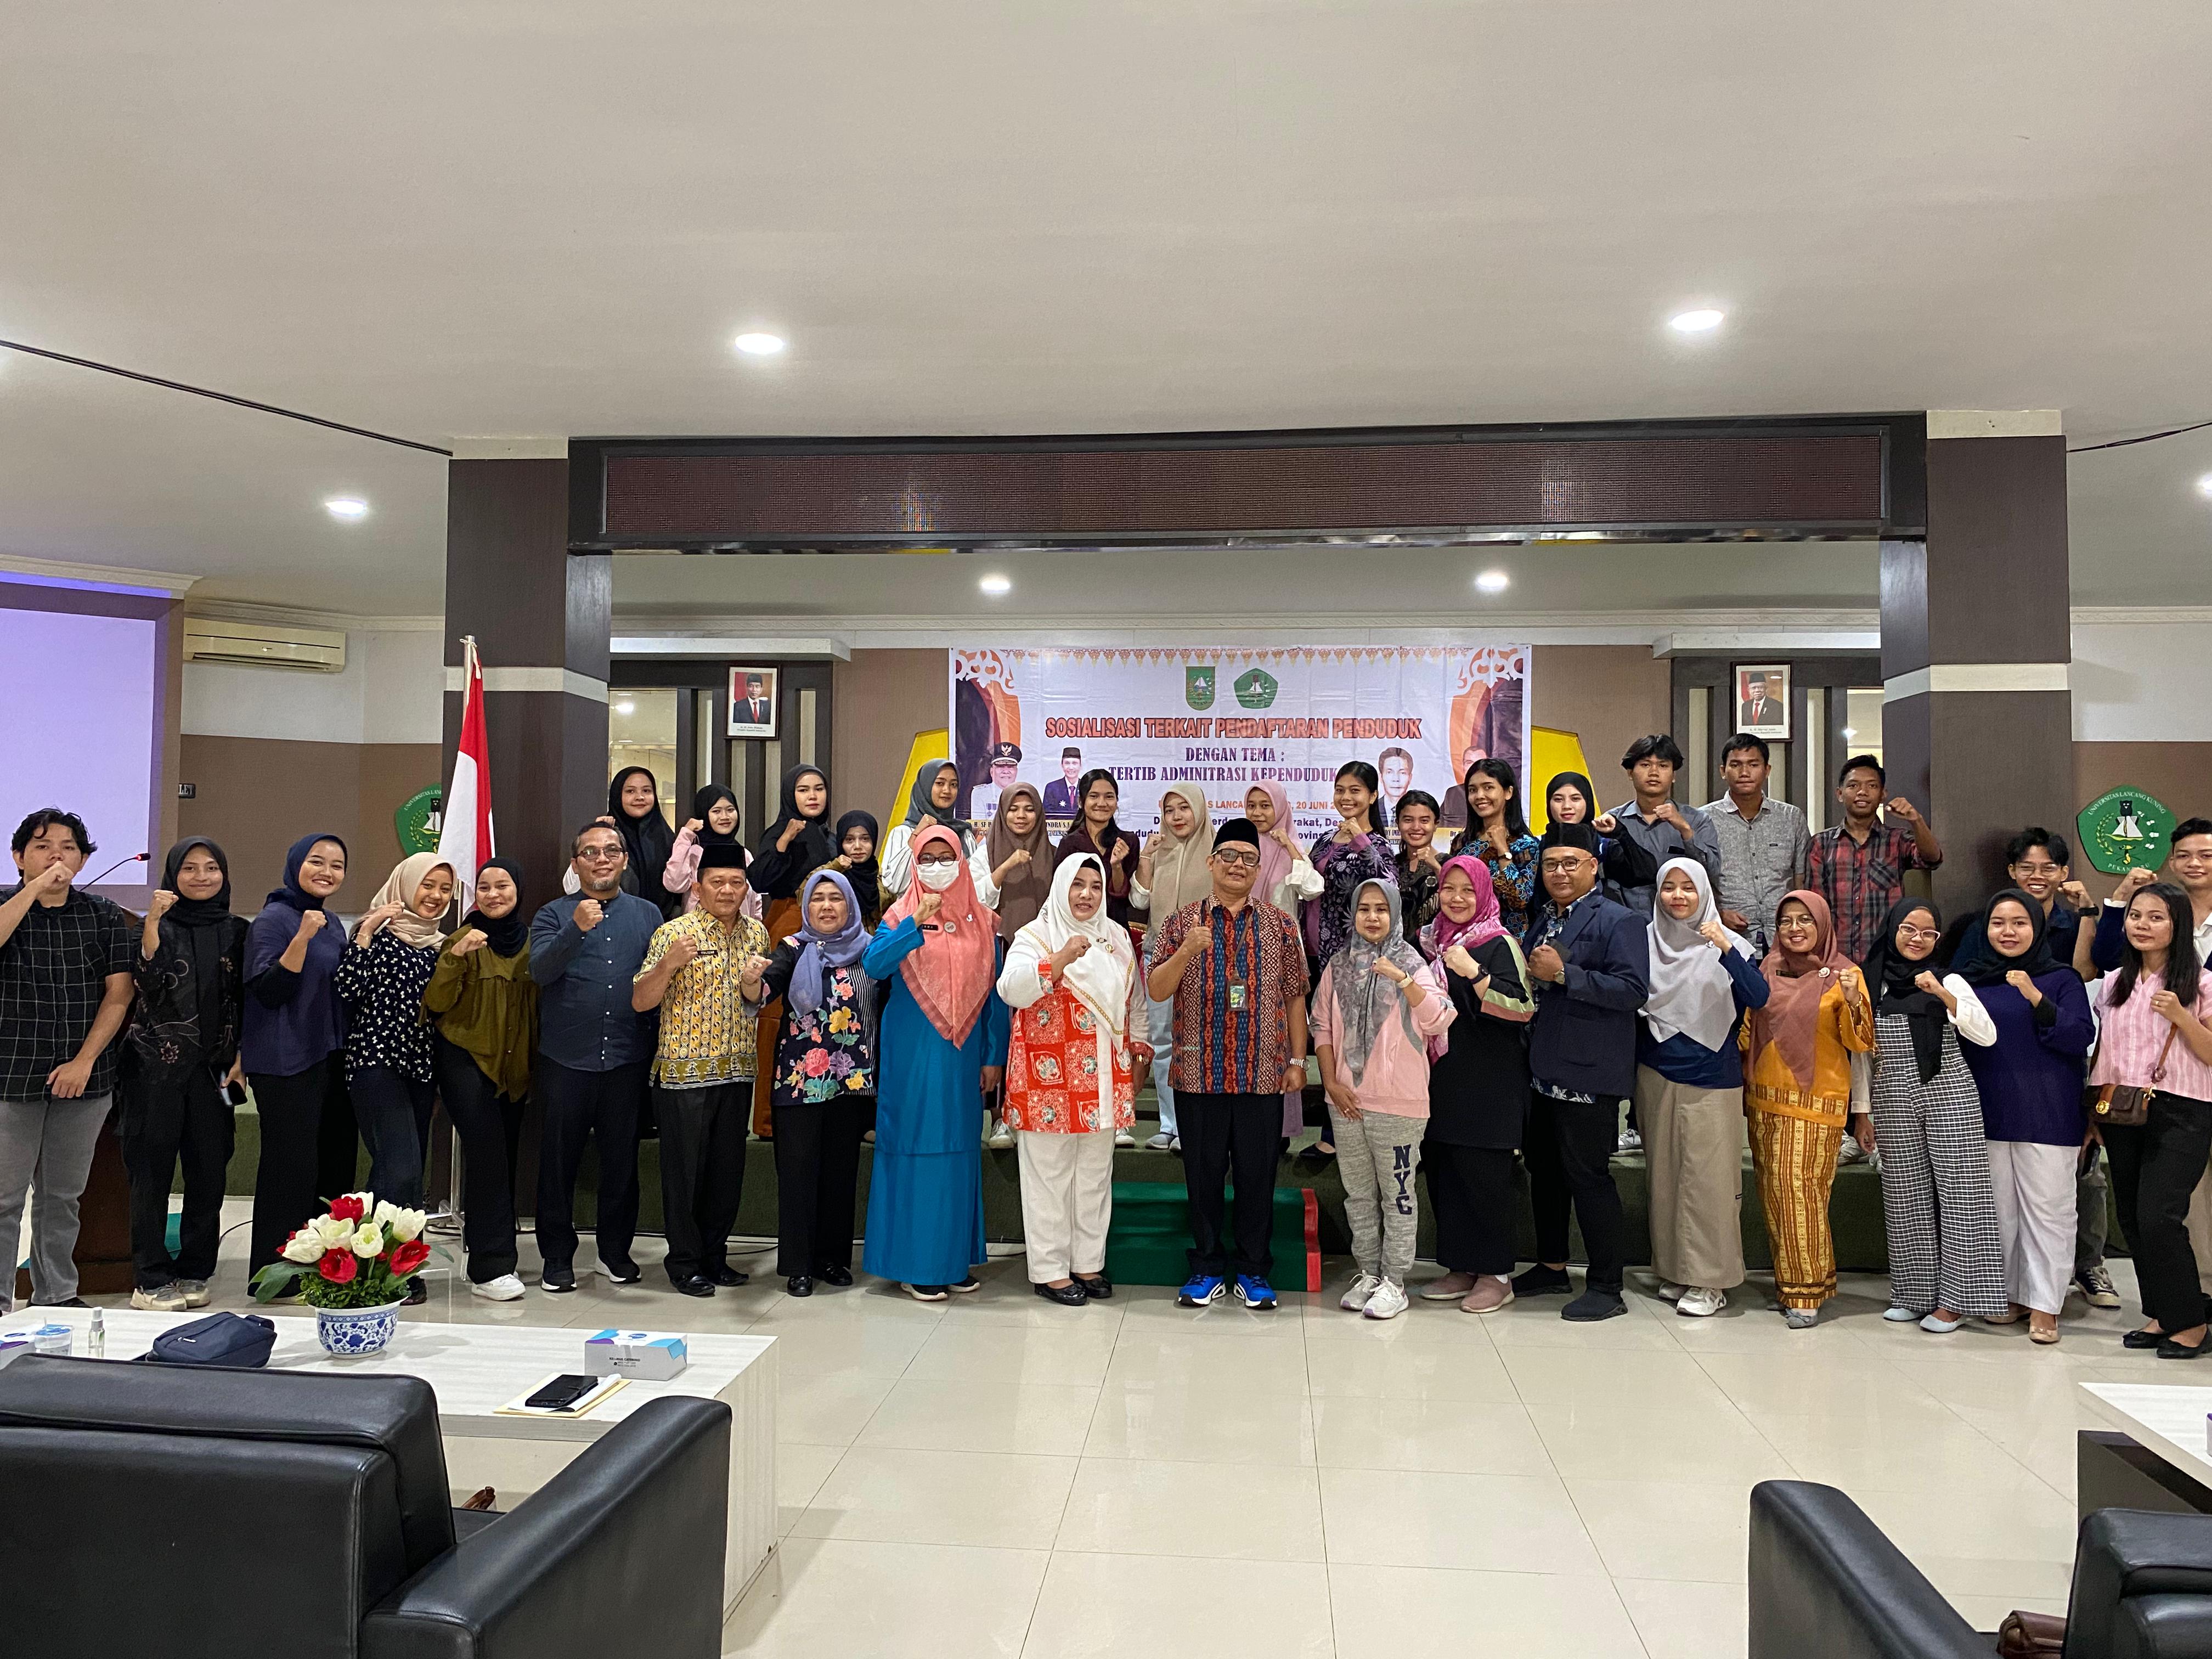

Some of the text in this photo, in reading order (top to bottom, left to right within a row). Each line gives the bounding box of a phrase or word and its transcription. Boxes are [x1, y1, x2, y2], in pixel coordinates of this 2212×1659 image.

[1046, 718, 1421, 738] SOSIALISASI TERKAIT PENDAFTARAN PENDUDUK
[1186, 747, 1237, 761] DENGAN
[1242, 748, 1276, 762] TEMA
[1109, 766, 1337, 782] TERTIB ADMINITRASI KEPENDUDUK
[404, 791, 431, 811] UNIVERSITAS
[1216, 800, 1244, 809] LANCA
[2087, 792, 2166, 815] UNIVERSITAS LANCANG KUNING
[1294, 817, 1322, 828] rakat,
[1393, 1144, 1412, 1215] NYC
